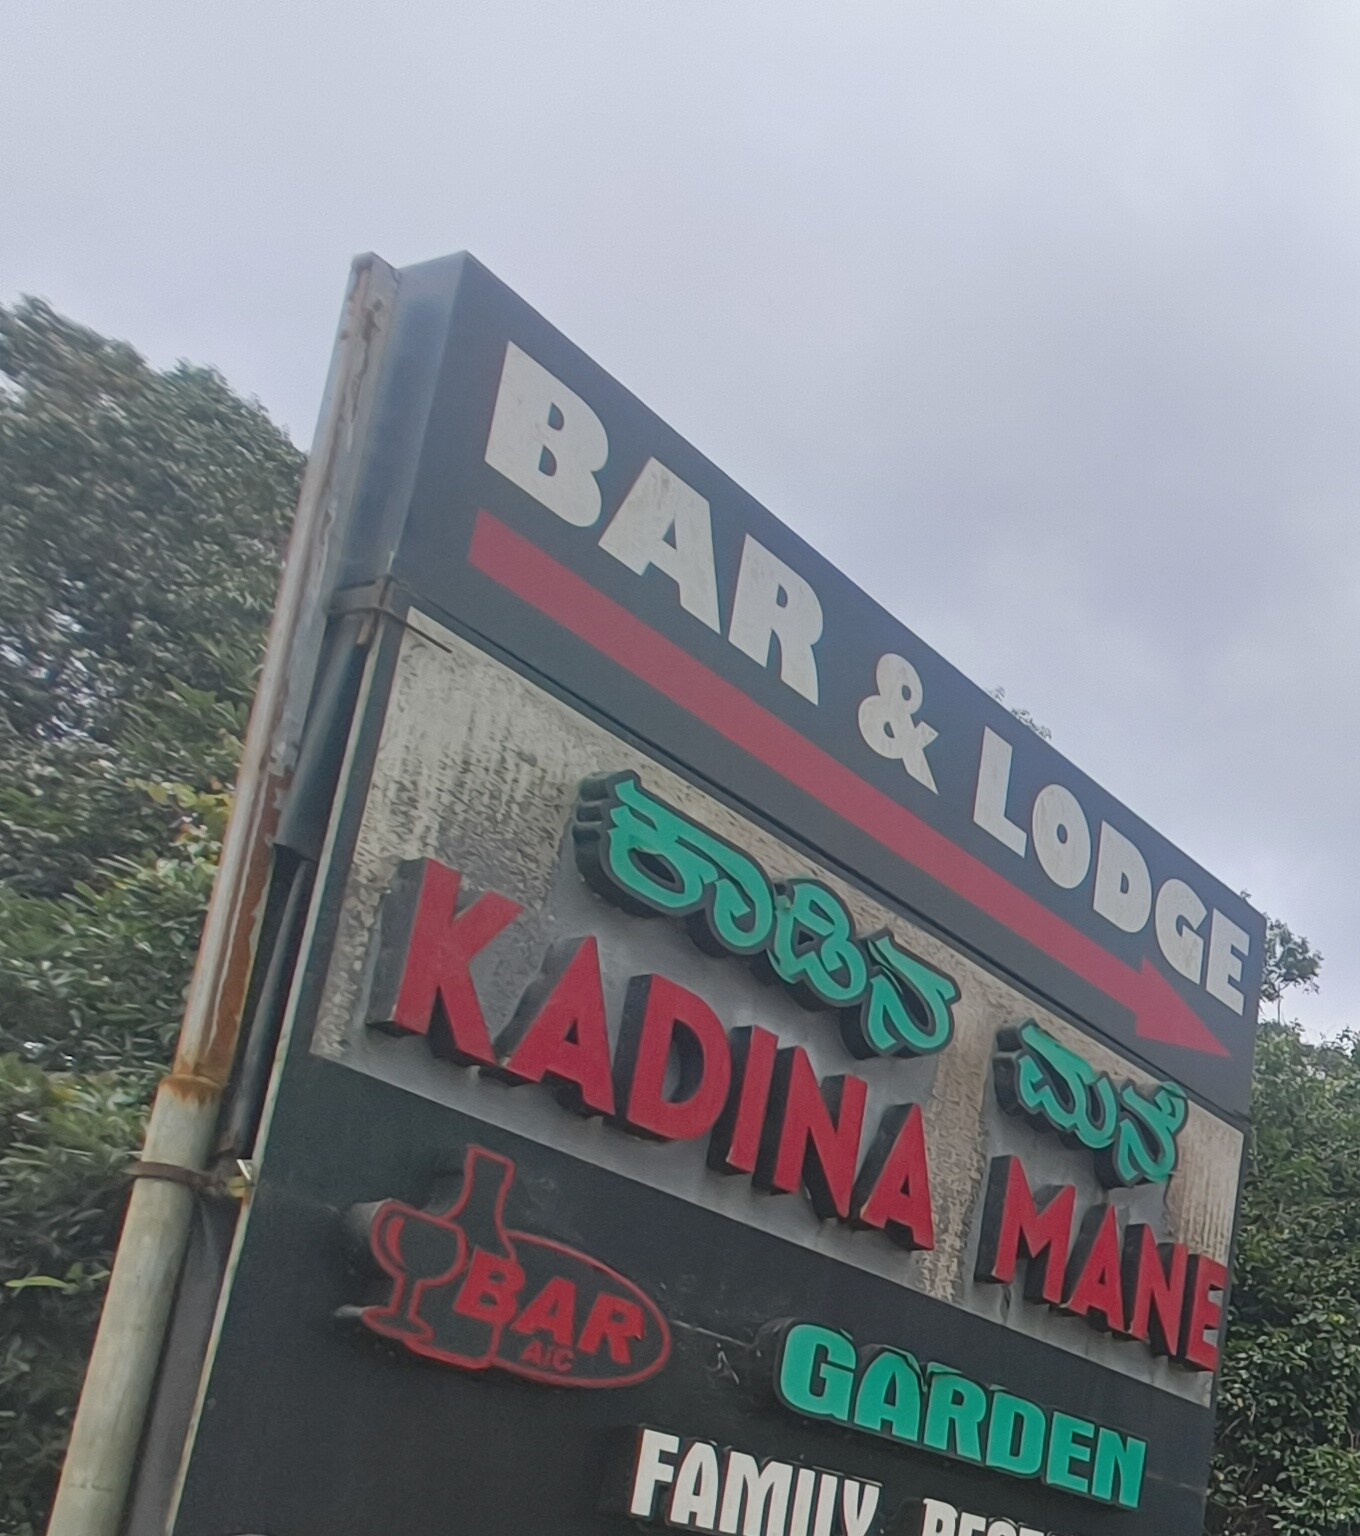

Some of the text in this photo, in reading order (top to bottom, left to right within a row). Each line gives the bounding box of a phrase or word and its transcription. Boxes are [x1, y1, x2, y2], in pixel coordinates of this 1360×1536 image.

[484, 340, 1250, 1016] BAR & LODGE
[394, 858, 1229, 1371] KADINA MANE
[607, 779, 1187, 1183] ಕಾಡಿನ ಮನೆ
[453, 1249, 645, 1364] BAR
[780, 1323, 1147, 1509] GARDEN
